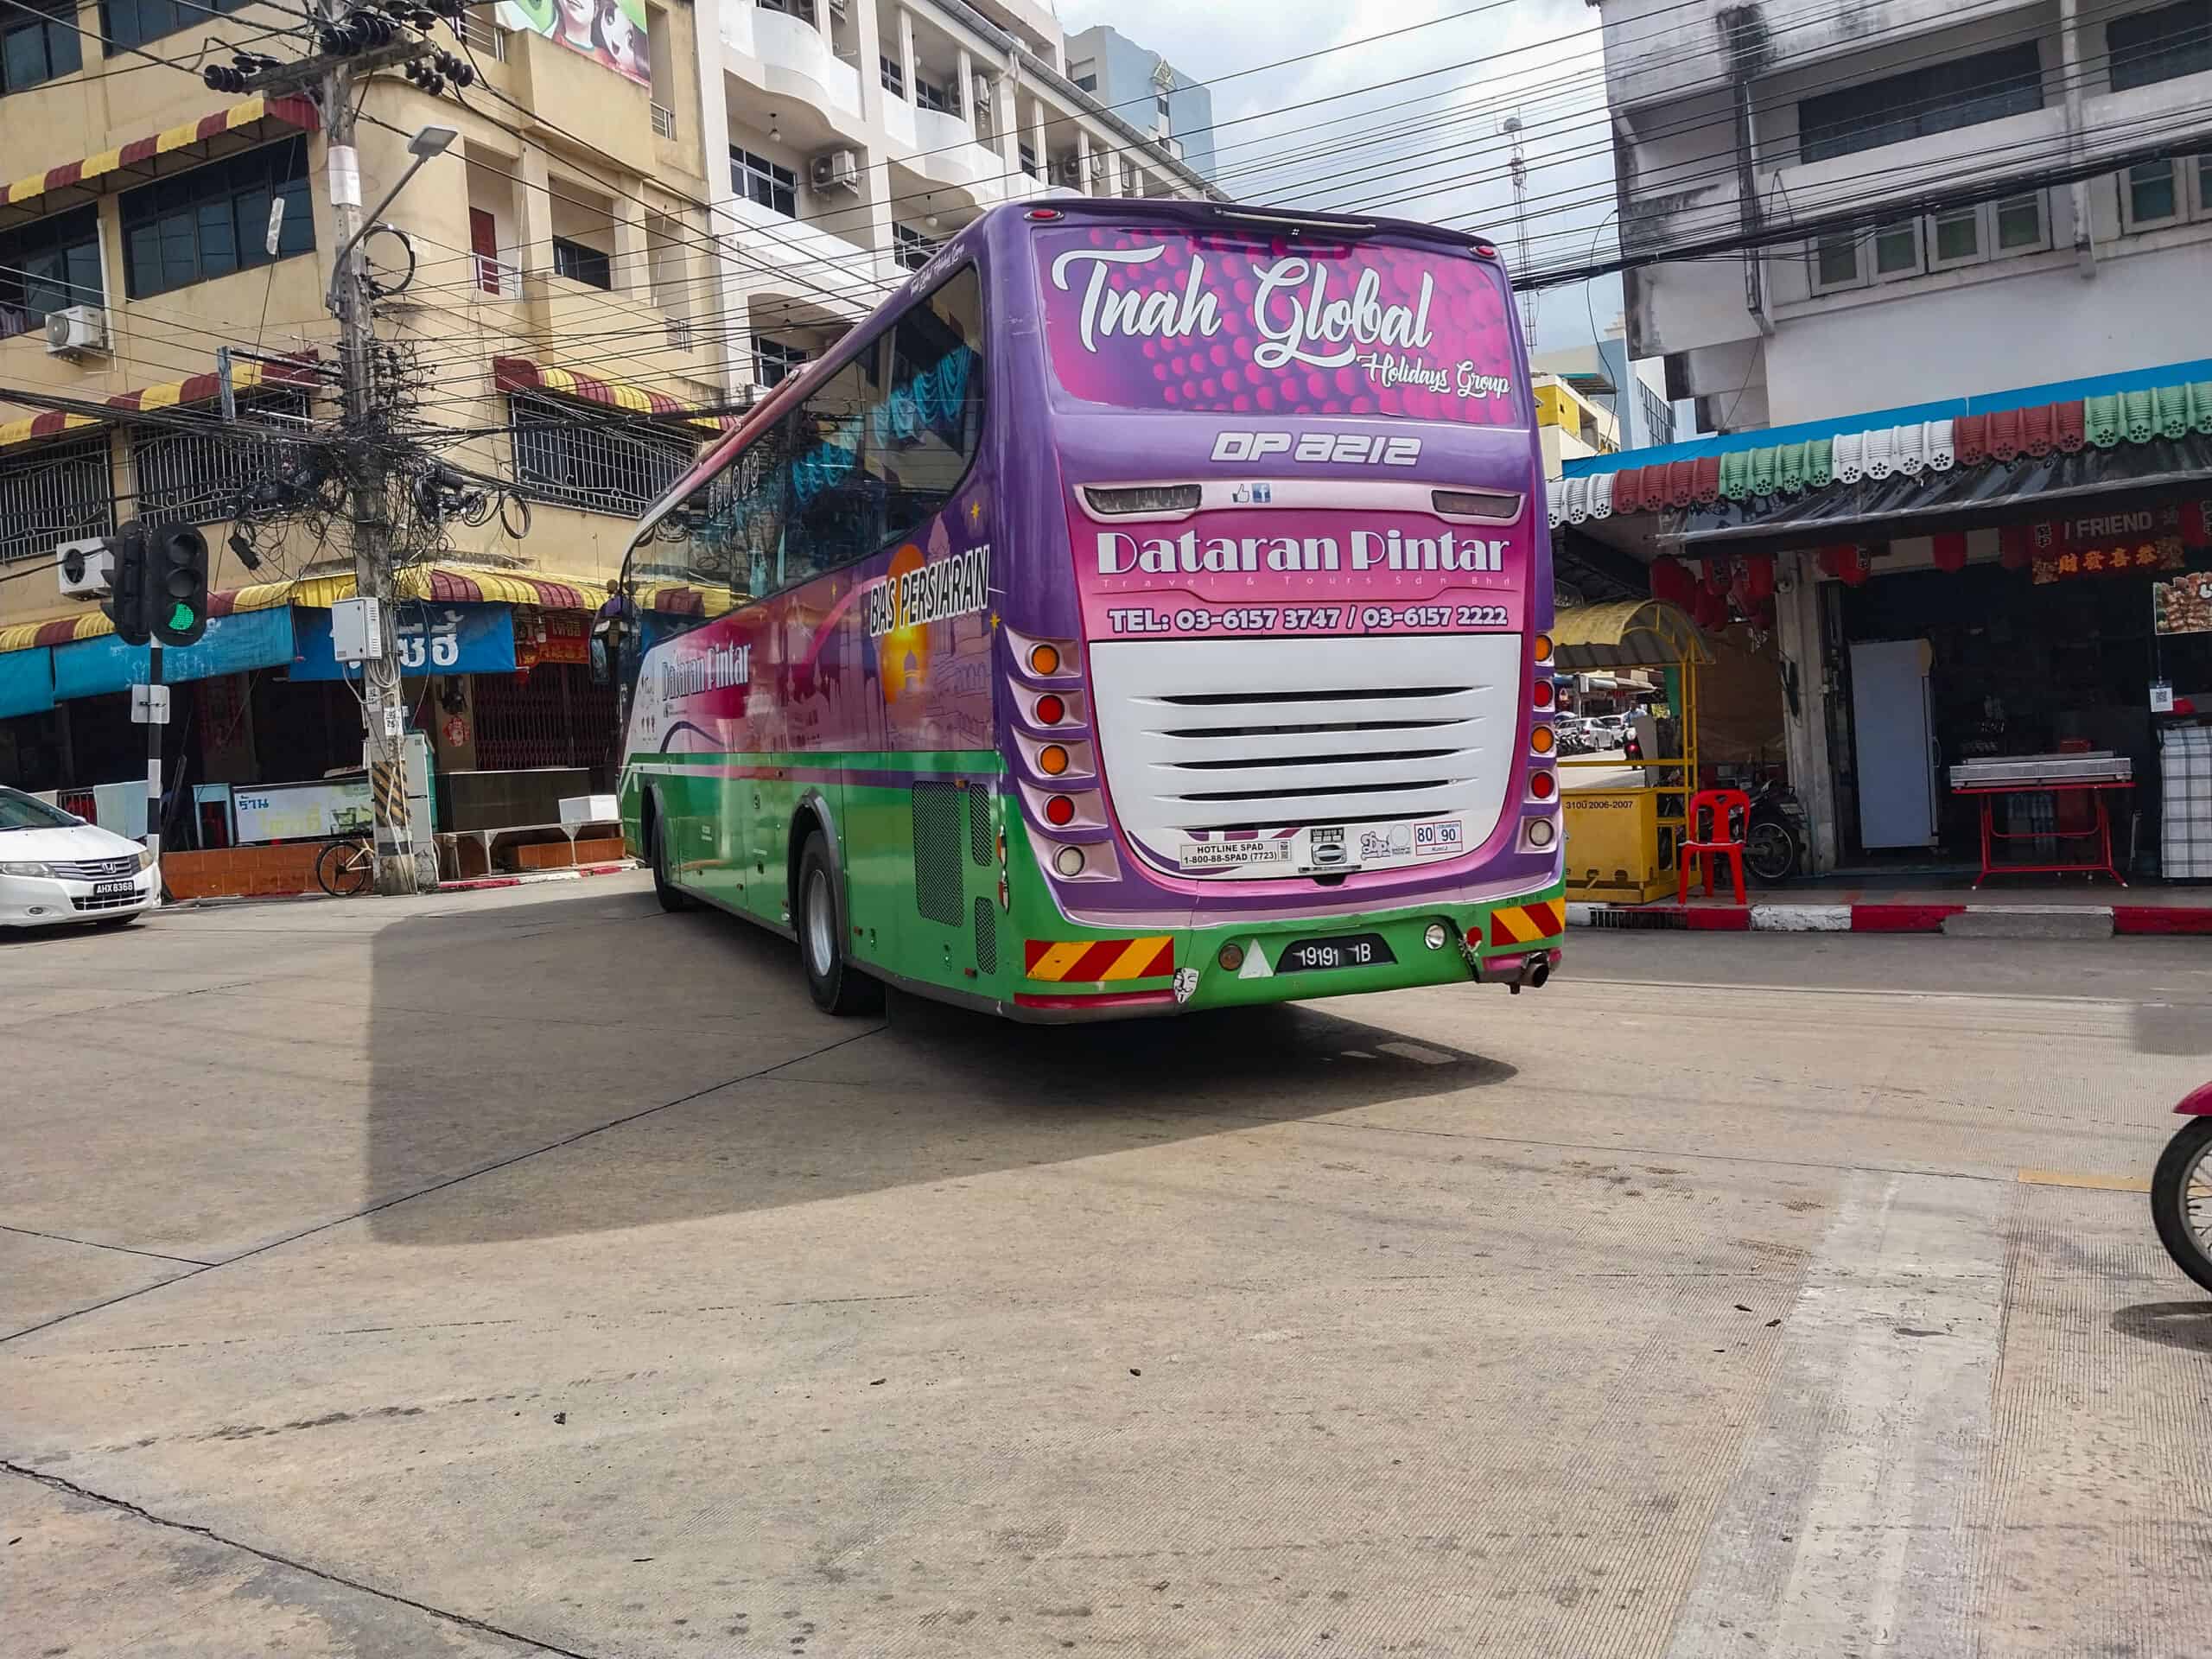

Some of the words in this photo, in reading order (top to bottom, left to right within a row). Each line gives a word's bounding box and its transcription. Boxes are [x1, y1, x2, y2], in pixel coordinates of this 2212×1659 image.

[1252, 257, 1434, 368] Global
[1356, 352, 1450, 393] Holidays
[1456, 360, 1510, 399] Group
[2076, 512, 2152, 537] FRIEND
[1097, 531, 1339, 574] Dataran
[1351, 530, 1510, 571] Pintar
[870, 576, 897, 637] BAS
[899, 544, 990, 628] PERSIARAN
[1103, 577, 1215, 588] Travel
[1247, 576, 1254, 586] &
[1284, 576, 1371, 585] Tours
[1395, 575, 1447, 585] Sdn
[1471, 576, 1510, 585] Bhd
[1109, 609, 1168, 632] TEL:
[1176, 609, 1277, 630] 03-6157
[1285, 608, 1340, 628] 3747
[1346, 607, 1356, 628] /
[1363, 607, 1452, 627] 03-6157
[1457, 607, 1508, 625] 2222
[707, 640, 751, 691] Pintar
[1417, 828, 1433, 842] 80
[1441, 828, 1456, 842] 90
[1184, 853, 1248, 863] 1-800-88-SPAD
[1250, 851, 1277, 861] (7723)
[1197, 844, 1237, 854] HOTLINE
[1241, 842, 1263, 851] SPAD
[96, 884, 112, 893] AHX
